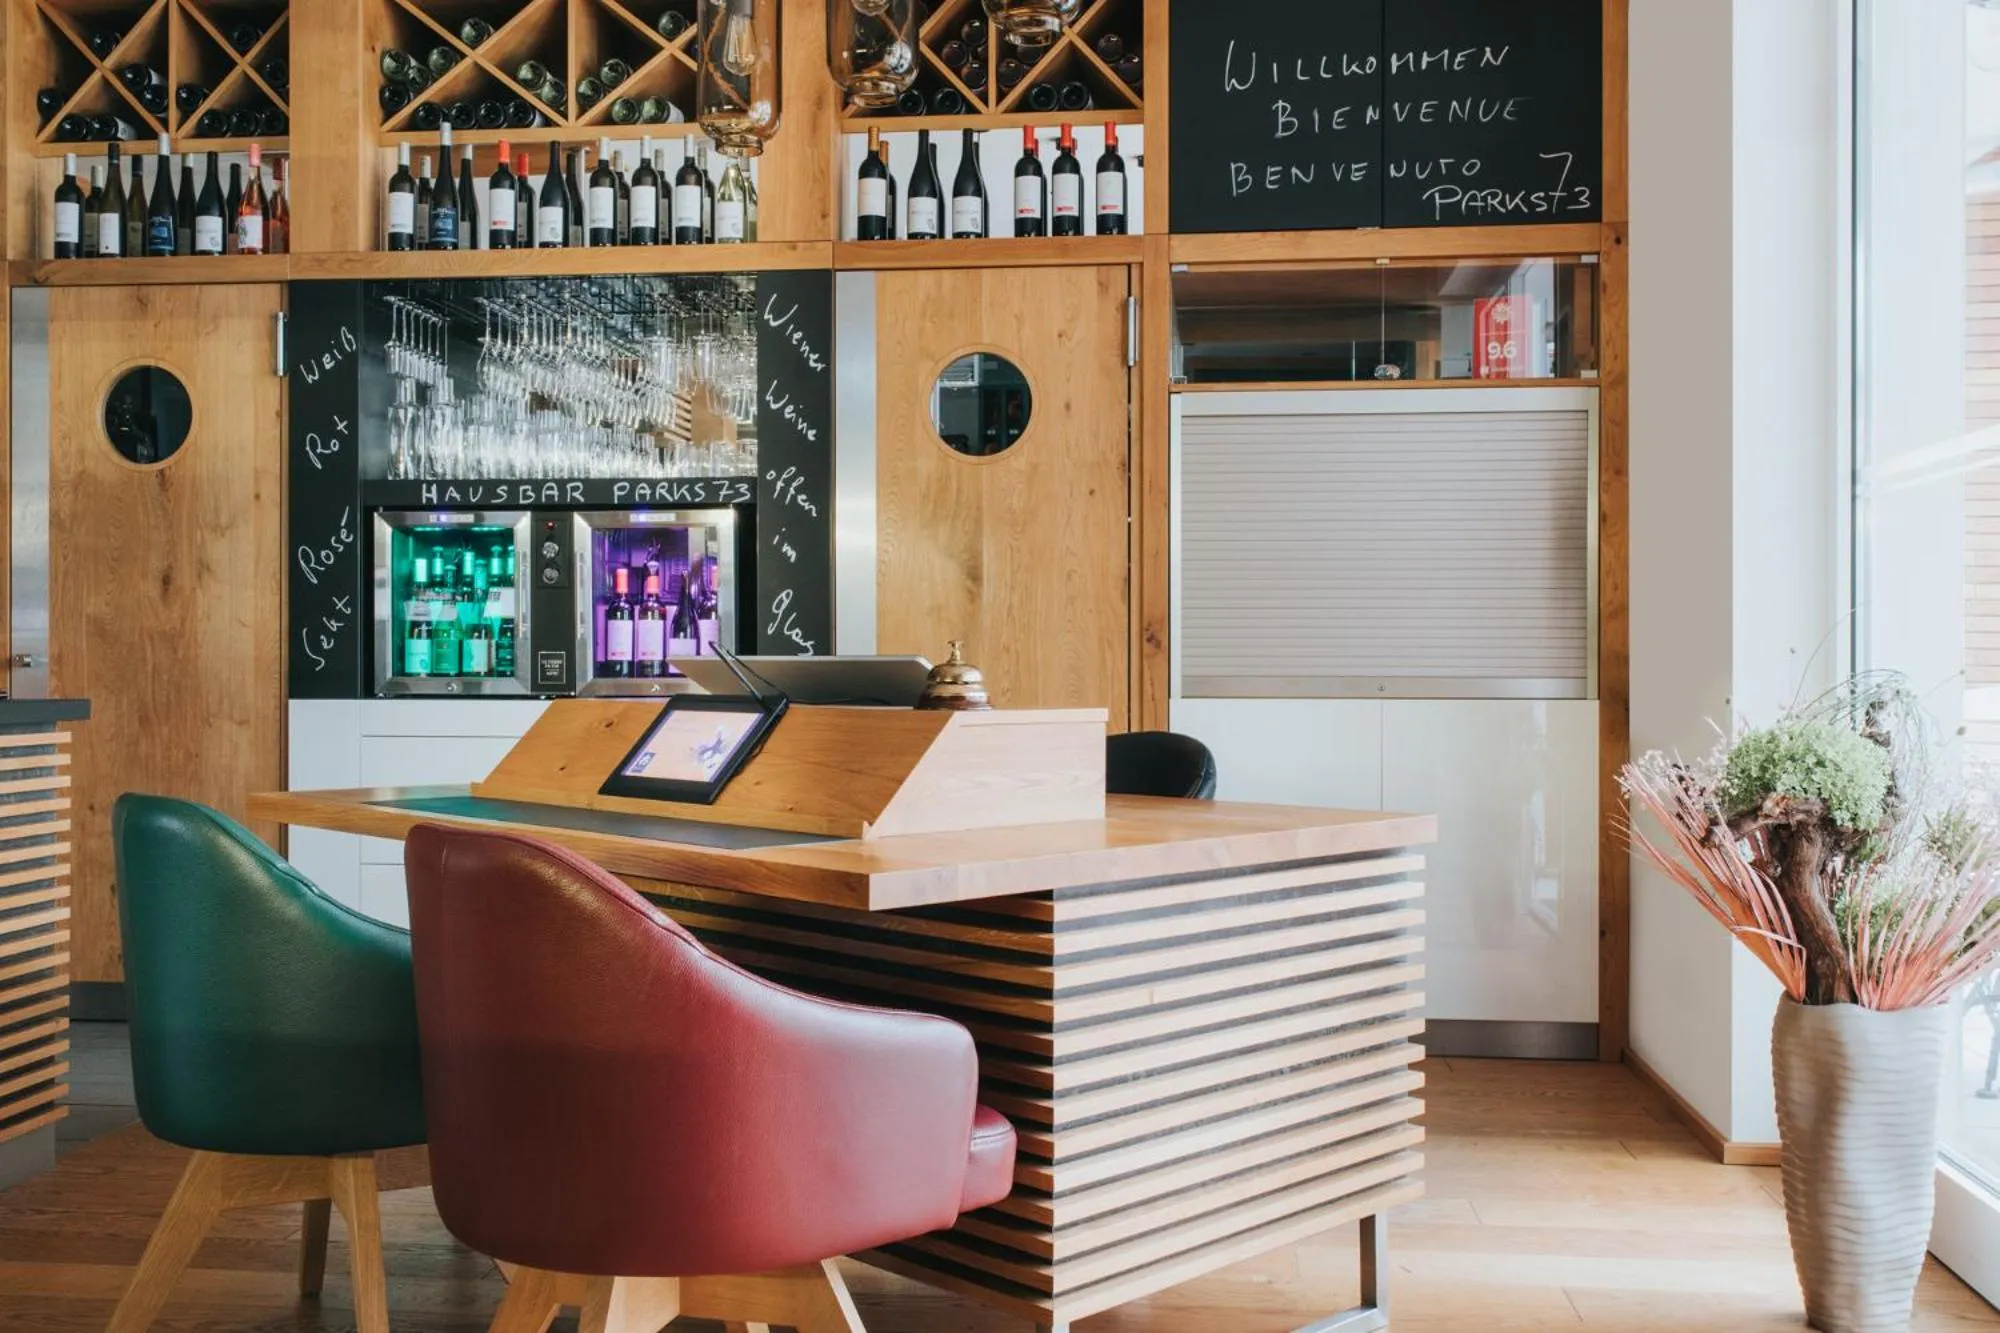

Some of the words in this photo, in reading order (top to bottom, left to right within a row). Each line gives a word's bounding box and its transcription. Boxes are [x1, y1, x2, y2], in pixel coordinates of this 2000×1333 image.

[1224, 40, 1509, 91] WILLKOMMEN
[1272, 97, 1530, 138] BIENVENUE
[1422, 152, 1591, 220] PARKS73
[299, 326, 356, 384] Weiß
[763, 293, 826, 372] Wiener
[765, 379, 817, 441] Weine
[305, 415, 350, 470] Rot
[421, 482, 585, 504] HAUSBAR
[613, 480, 752, 503] PARKS73
[765, 466, 818, 517] offen
[298, 505, 354, 584] Rosé
[773, 527, 798, 563] im
[302, 594, 352, 672] Sekt
